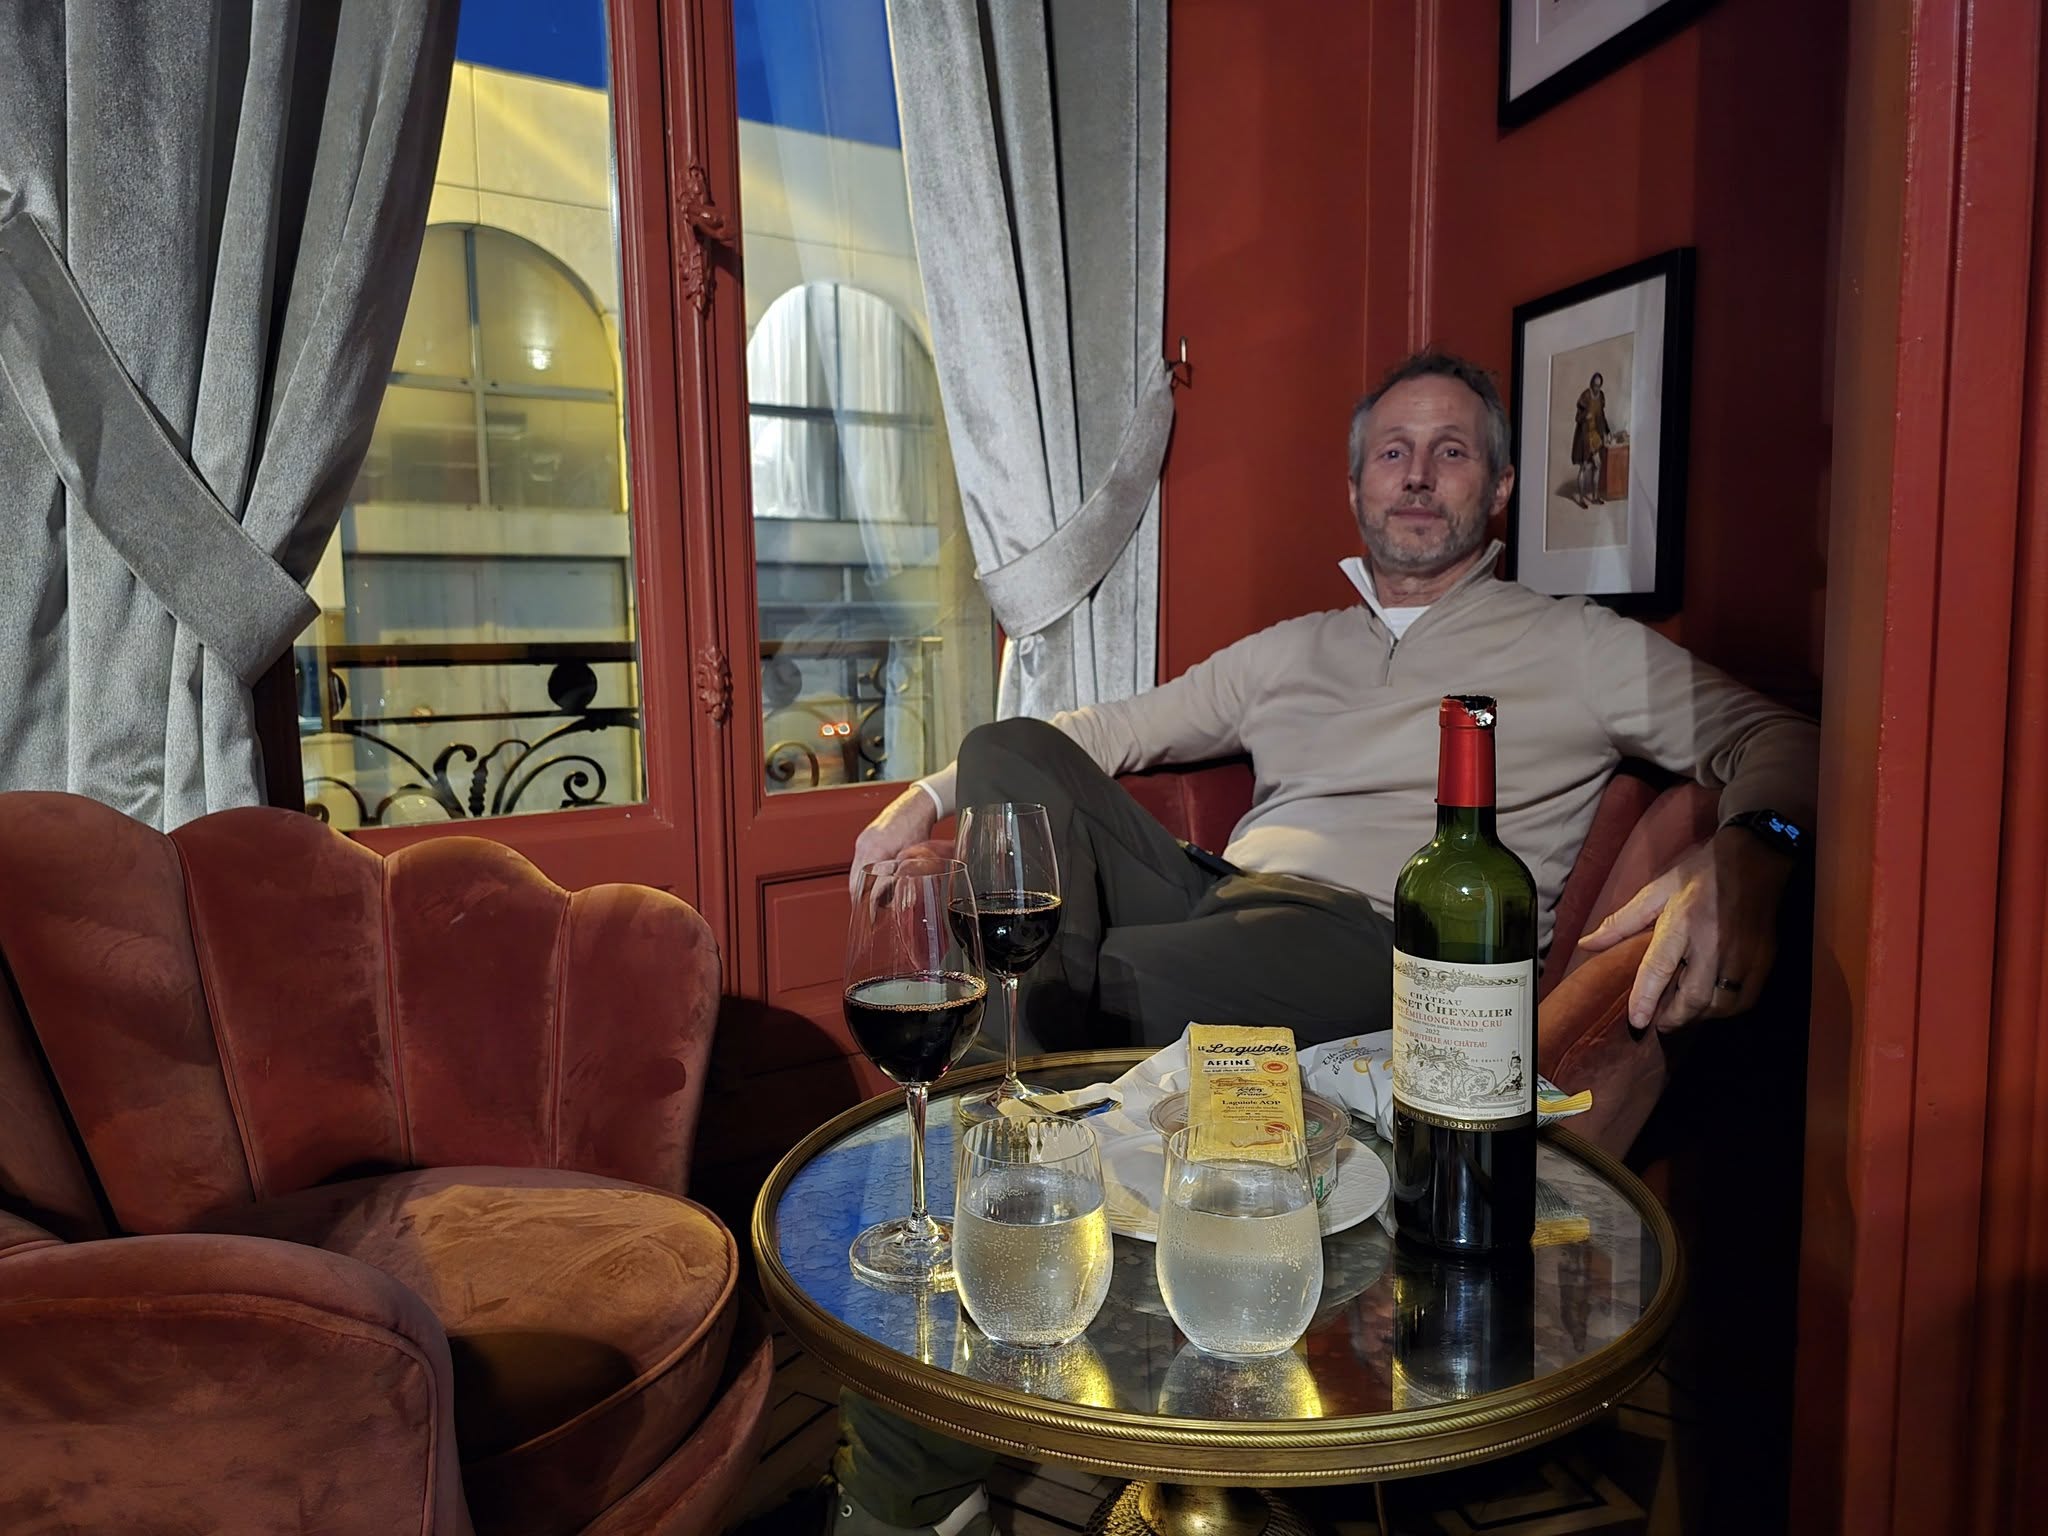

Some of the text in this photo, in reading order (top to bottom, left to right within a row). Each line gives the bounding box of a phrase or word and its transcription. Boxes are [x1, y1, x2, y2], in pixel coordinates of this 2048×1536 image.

[1410, 991, 1462, 1006] CHÂTEAU
[1425, 1002, 1513, 1018] CHEVALIER
[1482, 1020, 1503, 1028] CRU
[1425, 1027, 1441, 1036] 2022
[1453, 1039, 1488, 1048] CHÂTEAU
[1206, 1043, 1291, 1057] Laguiole
[1207, 1059, 1251, 1067] AFFINÉ
[1410, 1109, 1498, 1131] VIN DE BORDEAUX
